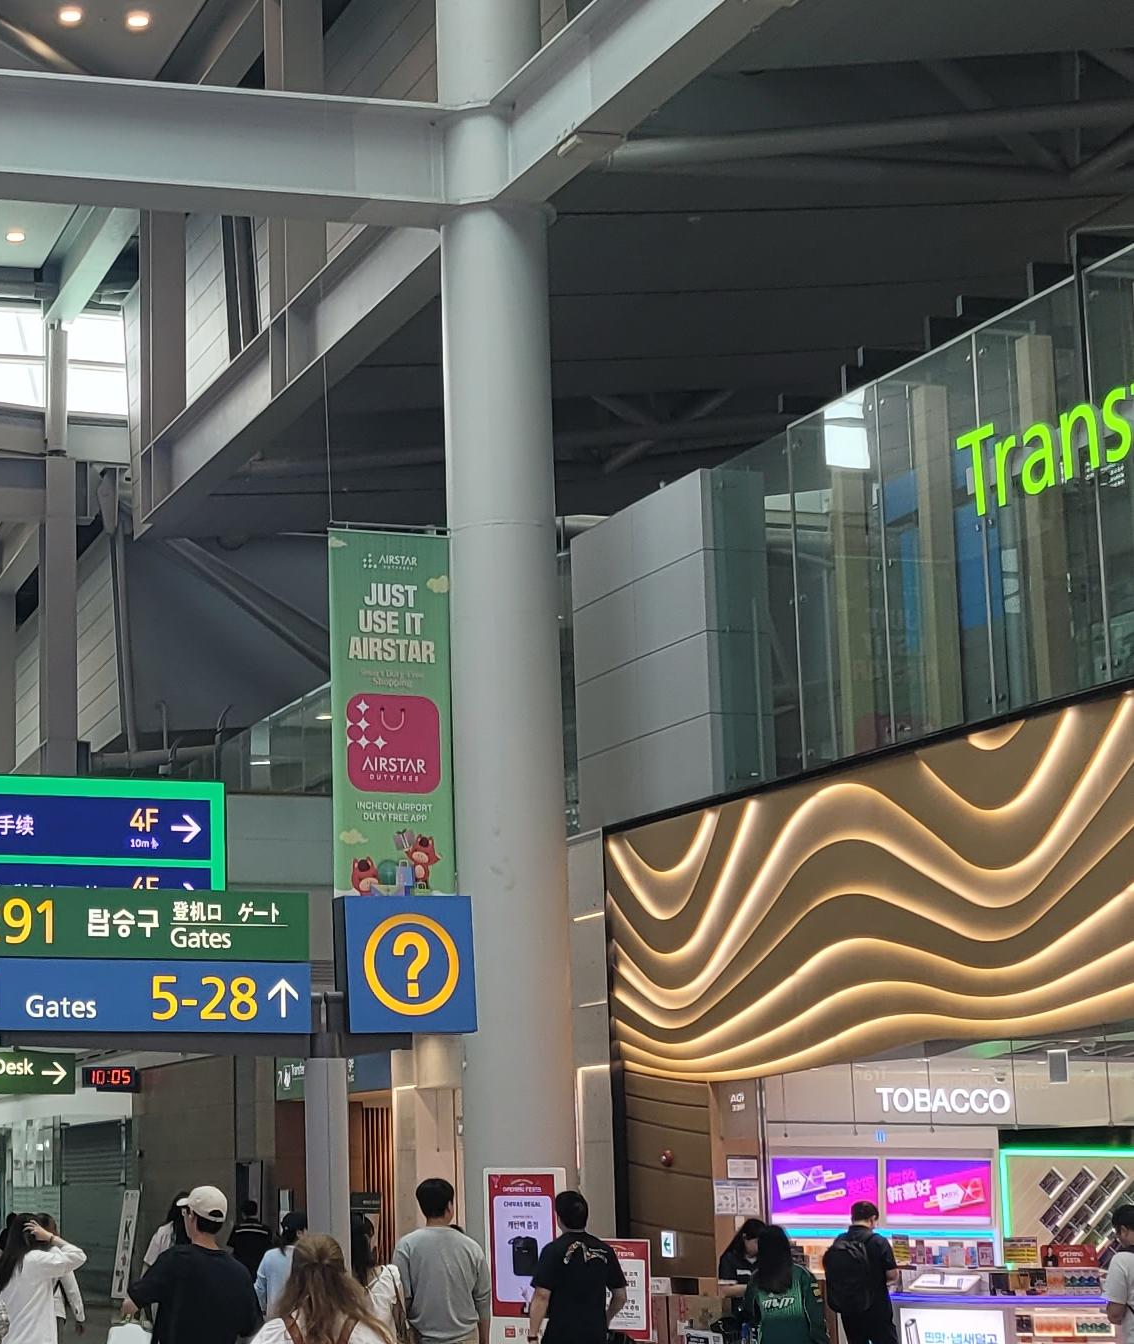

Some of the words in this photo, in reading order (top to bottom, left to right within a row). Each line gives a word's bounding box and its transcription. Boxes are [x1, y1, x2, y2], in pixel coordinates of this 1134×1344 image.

[956, 384, 1134, 516] Trans
[378, 554, 417, 566] AIRSTAR
[364, 582, 417, 608] JUST
[358, 610, 399, 635] USE
[405, 612, 424, 635] IT
[348, 636, 435, 664] AIRSTAR
[362, 756, 426, 774] AIRSTAR
[357, 801, 395, 812] INCHEON
[396, 802, 433, 813] AIRPORT
[363, 812, 387, 822] DUTY
[388, 813, 409, 822] FREE
[410, 813, 427, 823] APP
[129, 808, 159, 833] 4F
[130, 839, 150, 848] 10m
[87, 909, 159, 938] 탑승구
[172, 901, 222, 922] 登机口
[237, 902, 280, 923] ゲート
[170, 927, 231, 949] Gates
[25, 995, 97, 1019] Gates
[152, 975, 258, 1021] 5-28
[91, 1069, 132, 1085] 10:05
[875, 1087, 1011, 1114] TOBACCO
